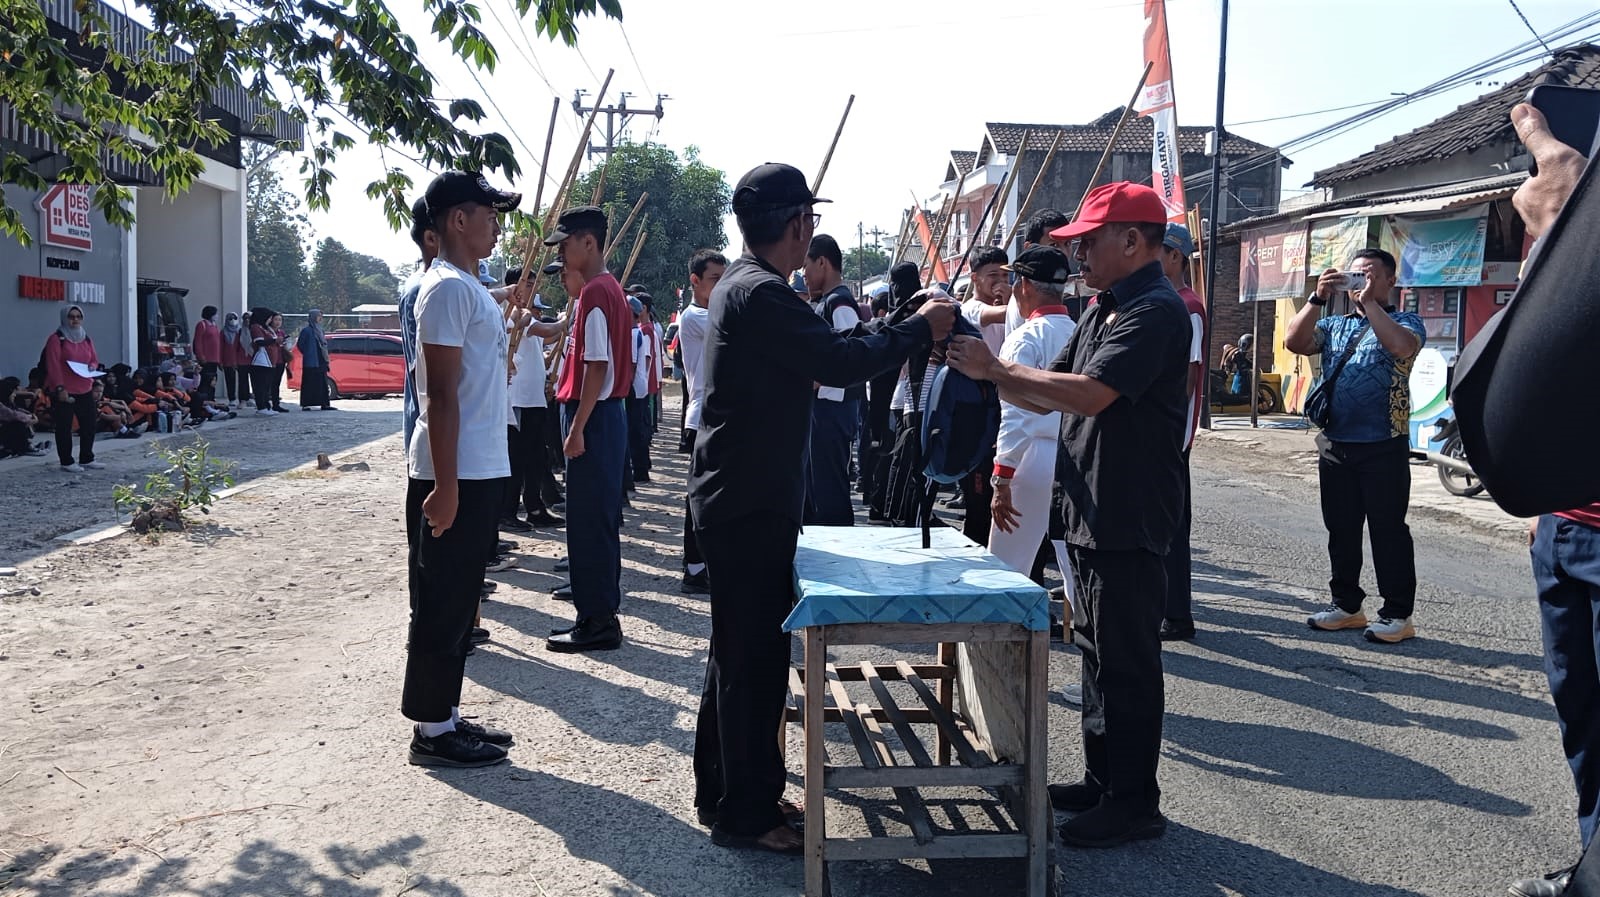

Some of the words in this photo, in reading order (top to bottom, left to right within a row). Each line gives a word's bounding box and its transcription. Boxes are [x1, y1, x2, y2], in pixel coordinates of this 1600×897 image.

[1156, 131, 1172, 198] DIRGAHAYU
[69, 194, 89, 211] DES
[69, 211, 90, 228] KEL
[46, 256, 80, 271] KOPERASI
[20, 275, 65, 301] MERAH
[73, 282, 105, 304] PUTIH
